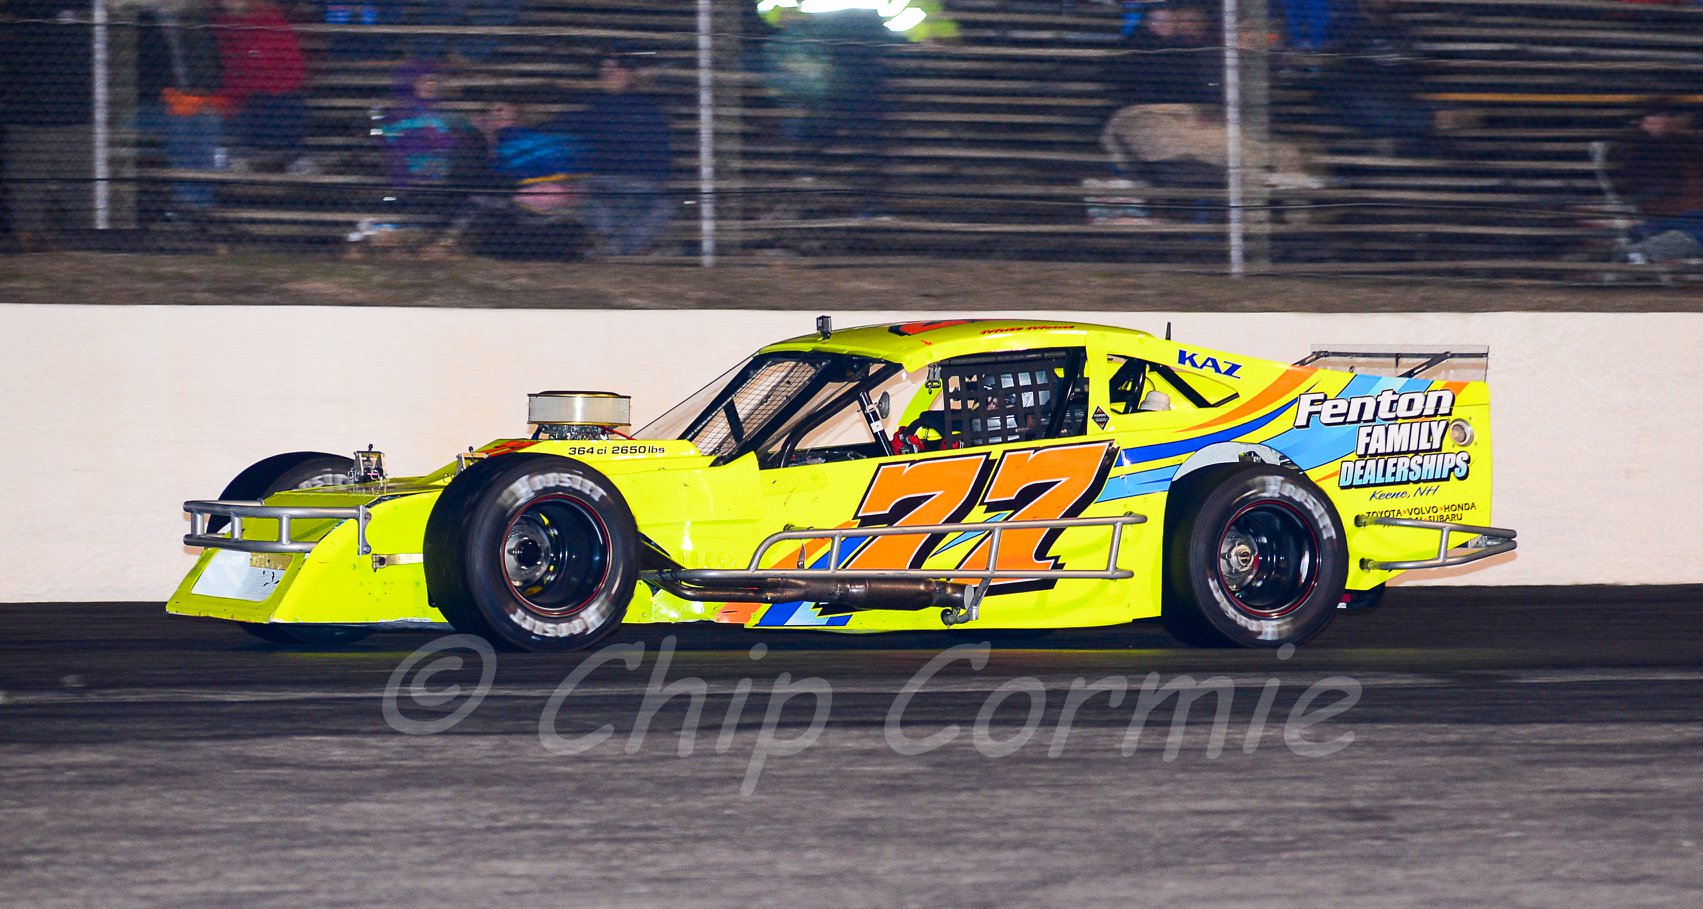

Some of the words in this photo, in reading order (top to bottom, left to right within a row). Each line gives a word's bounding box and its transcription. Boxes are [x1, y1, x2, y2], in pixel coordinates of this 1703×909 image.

[1178, 349, 1242, 379] KAZ
[1293, 388, 1456, 428] Fenton
[568, 446, 594, 456] 364
[596, 446, 607, 455] ci
[1355, 419, 1451, 457] FAMILY
[1338, 451, 1472, 490] DEALERSHIPS
[1369, 490, 1411, 501] Keene,
[1413, 485, 1440, 497] NH
[1407, 505, 1438, 516] VOLVO
[1443, 502, 1476, 513] HONDA
[840, 440, 1119, 596] 77
